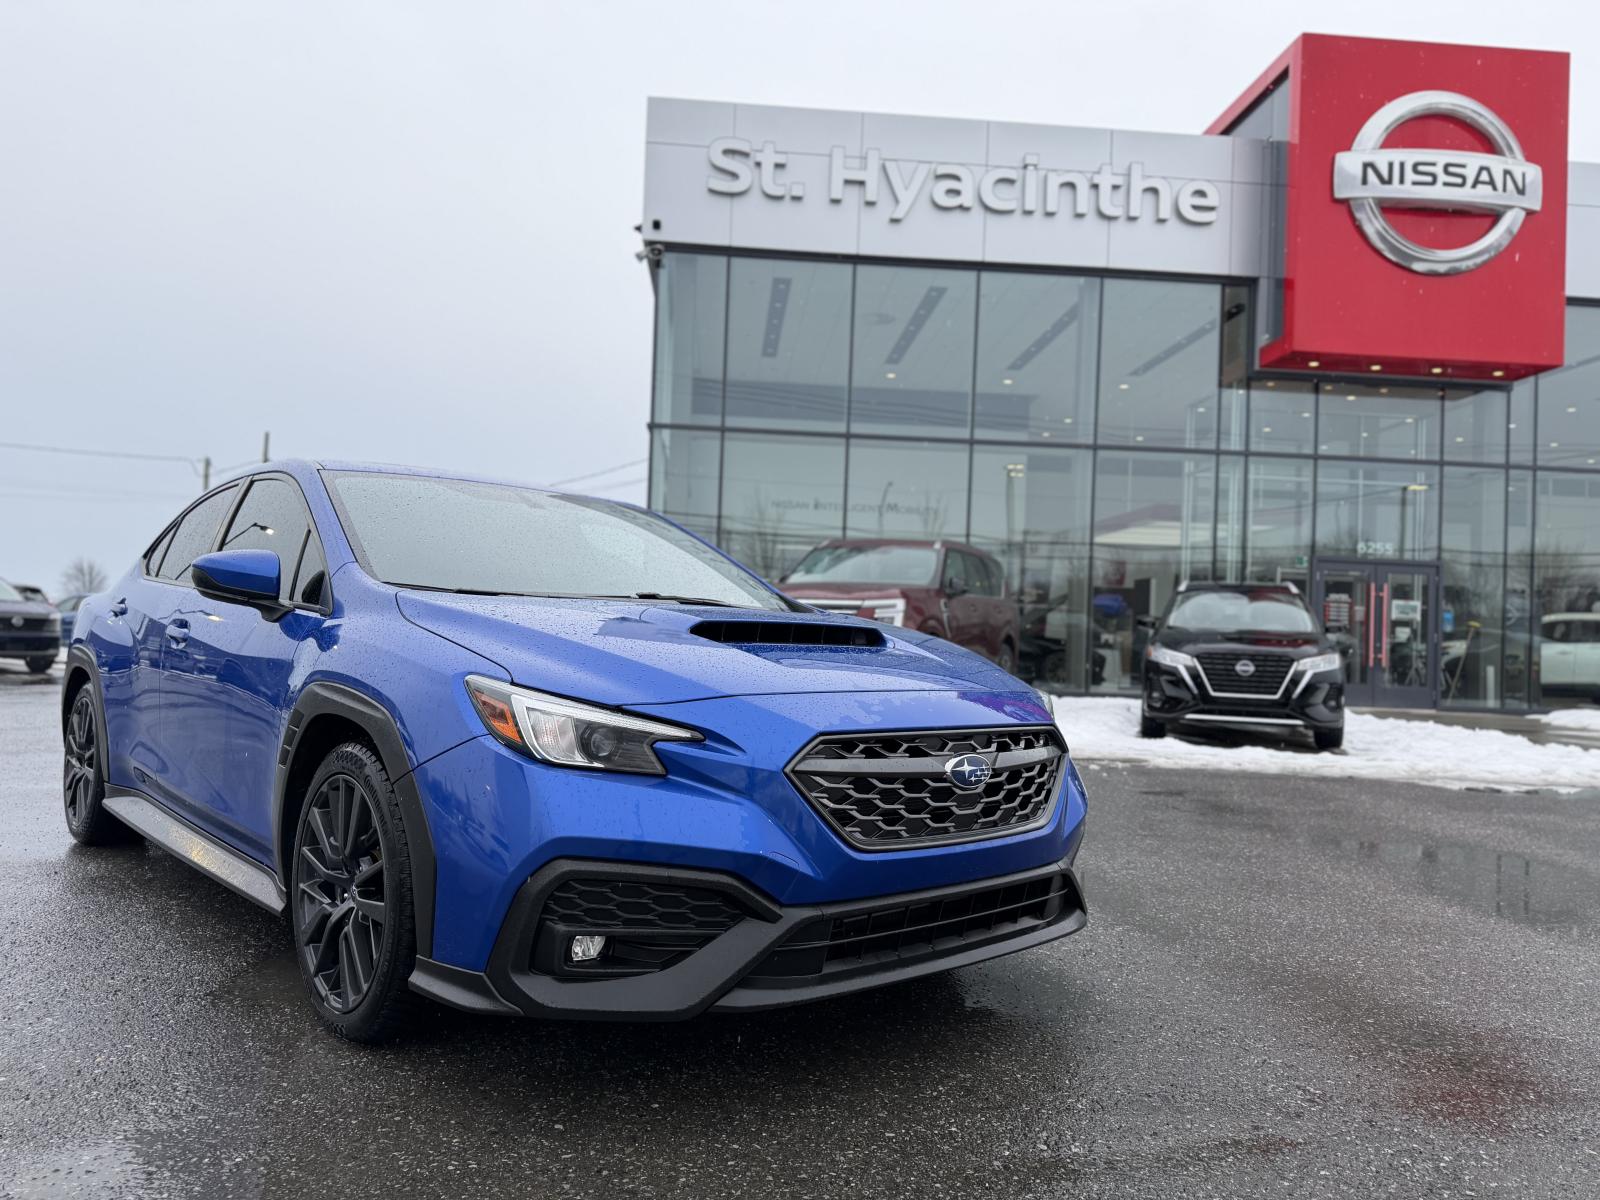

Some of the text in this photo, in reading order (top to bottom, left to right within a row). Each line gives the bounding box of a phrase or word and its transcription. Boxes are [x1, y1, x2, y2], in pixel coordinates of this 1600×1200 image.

[706, 136, 1220, 224] St. Hyacinthe
[1361, 160, 1527, 197] NISSAN
[1356, 541, 1393, 554] 6255
